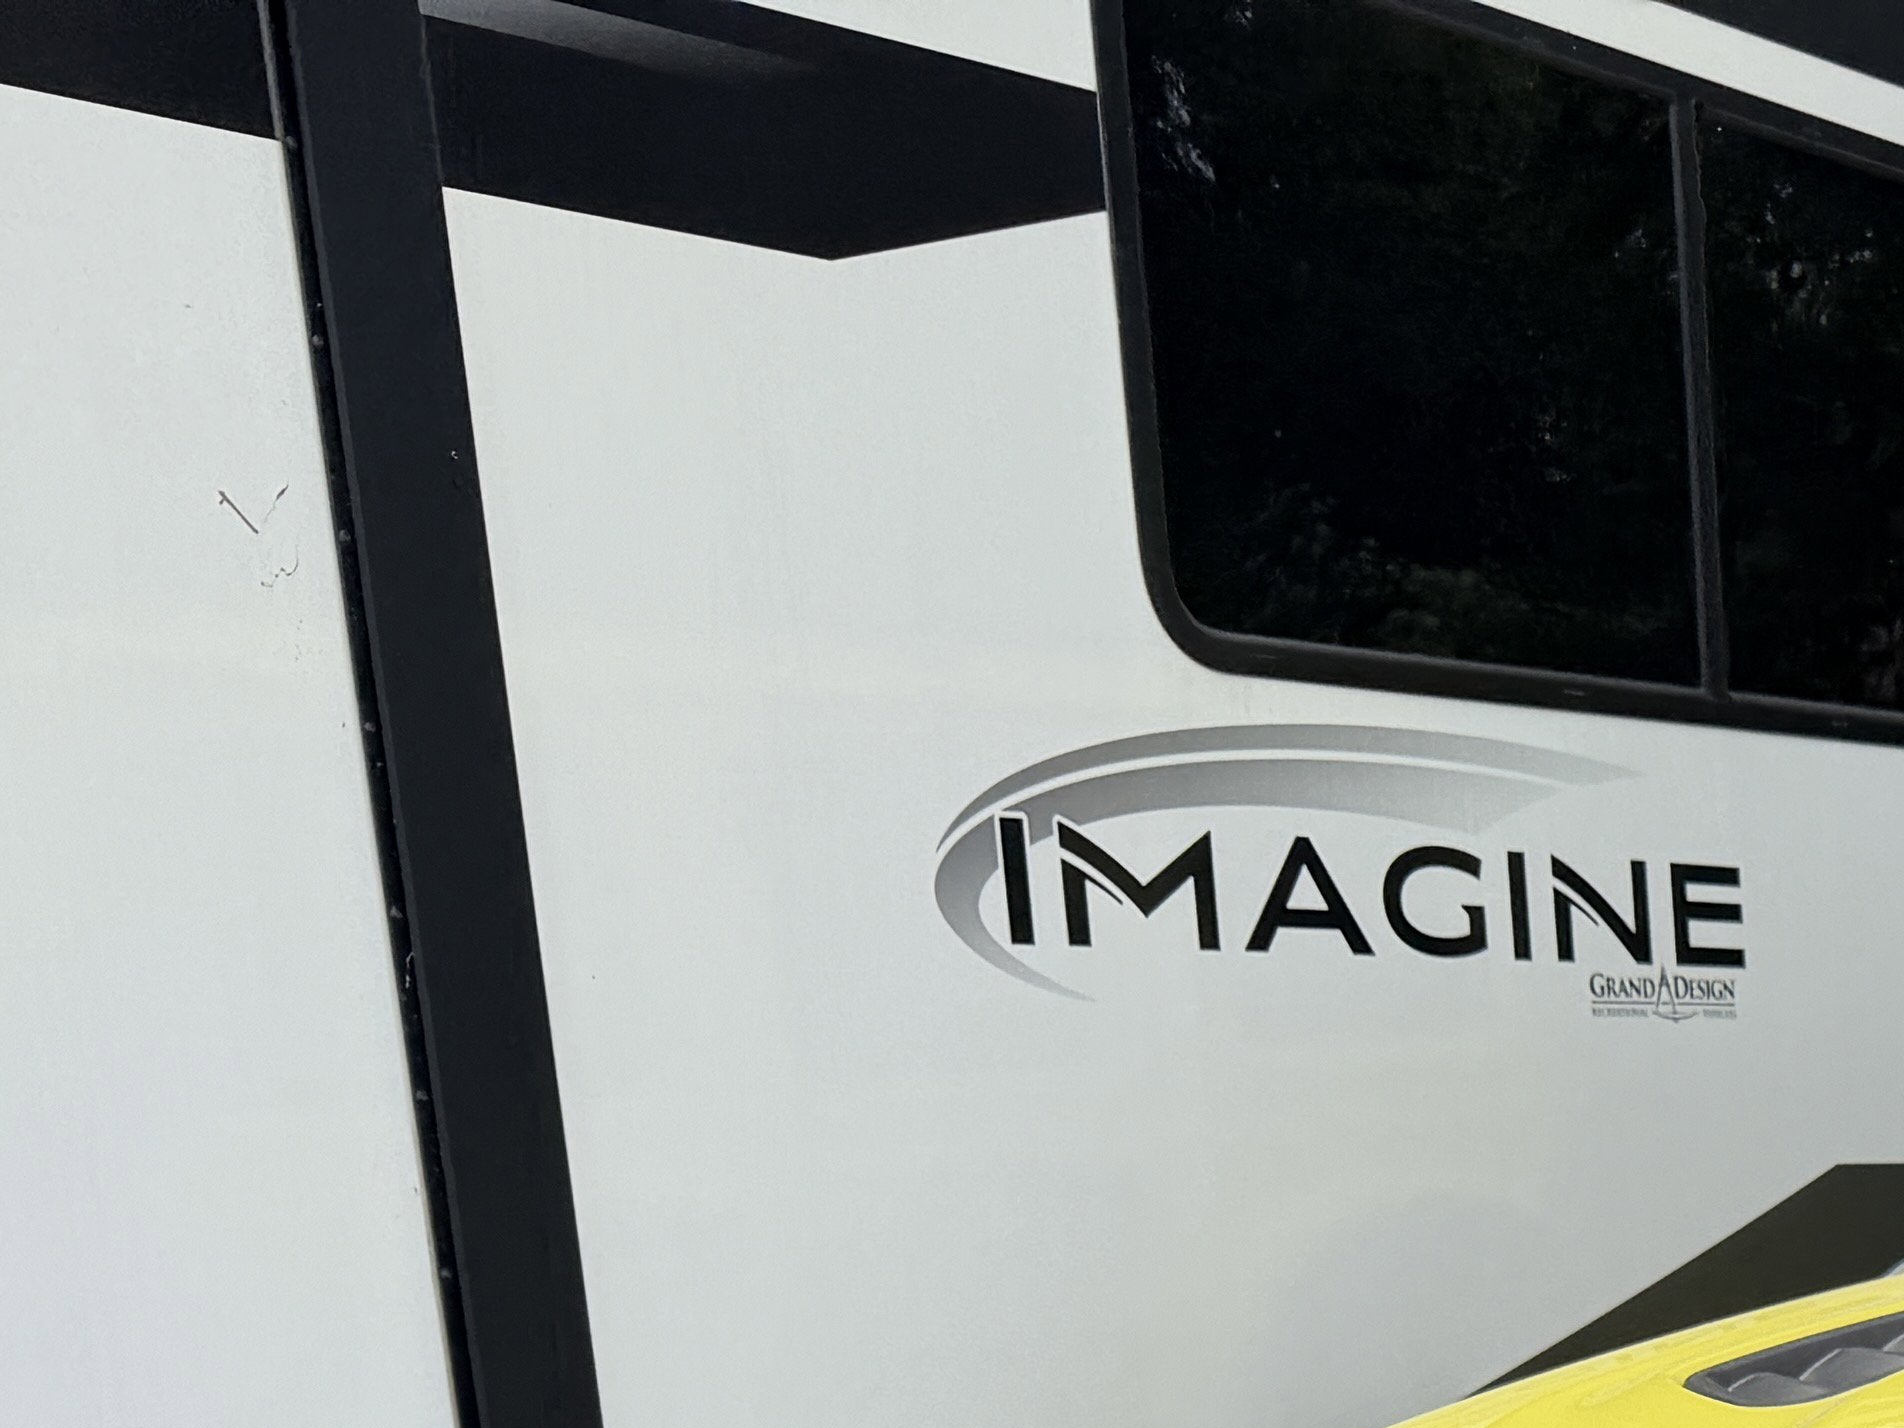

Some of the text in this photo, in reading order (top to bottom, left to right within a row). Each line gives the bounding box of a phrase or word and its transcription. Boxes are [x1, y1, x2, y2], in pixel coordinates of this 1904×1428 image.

[999, 815, 1746, 969] IMAGINE
[1589, 972, 1736, 1001] GRAND DESIGN
